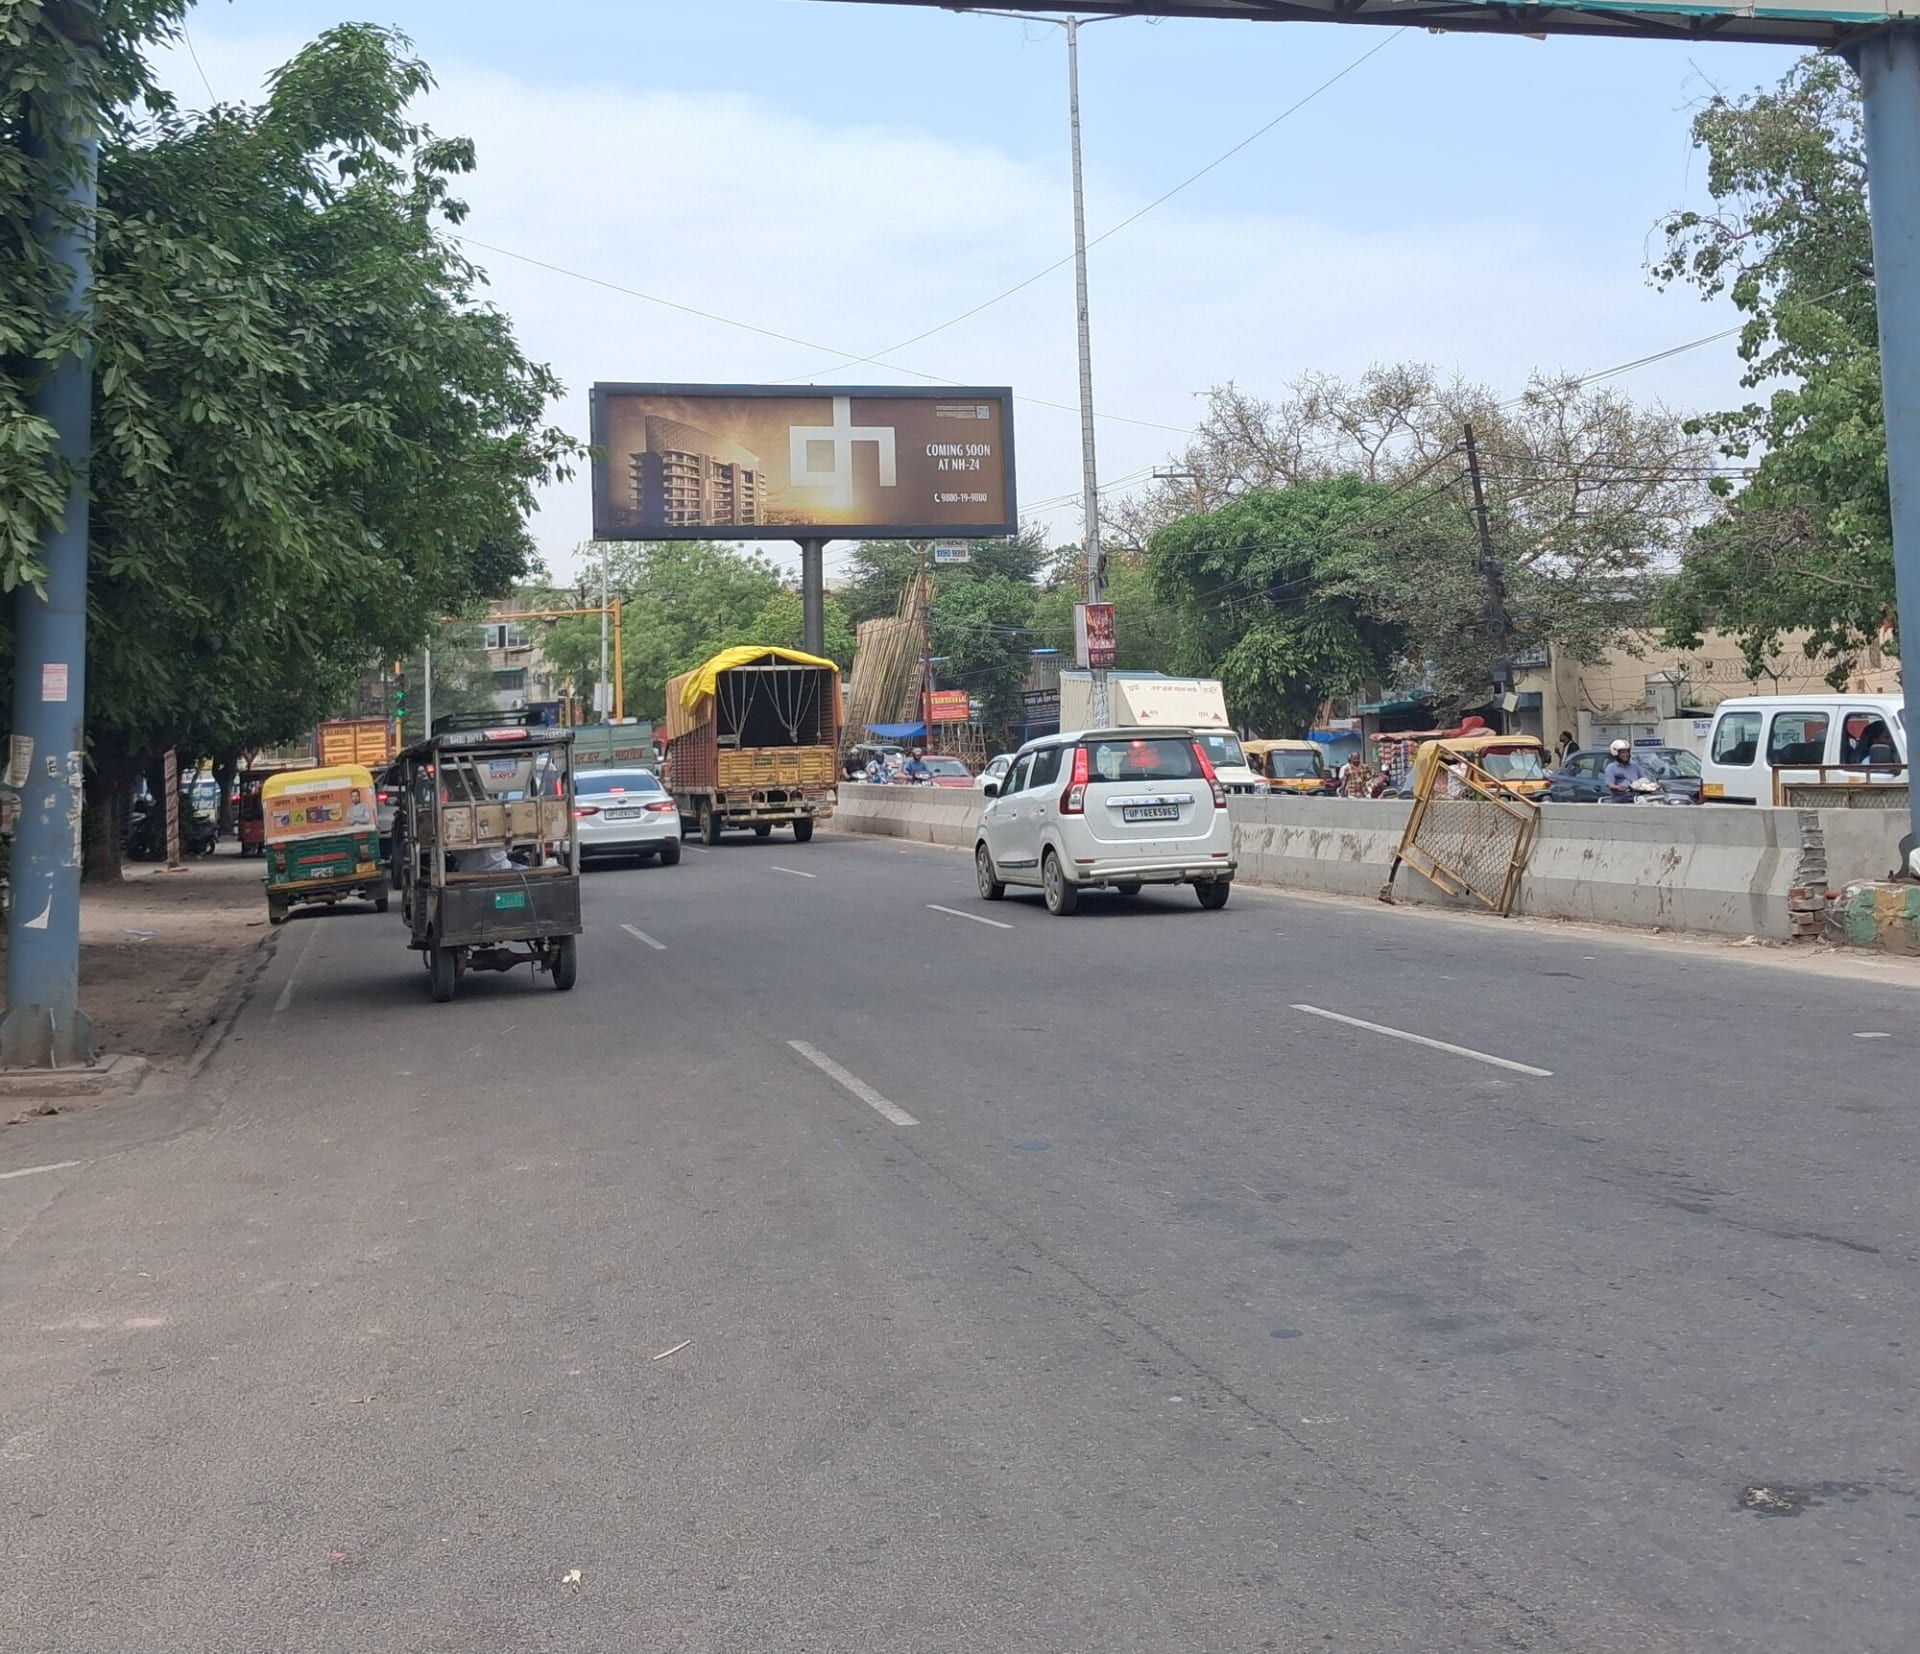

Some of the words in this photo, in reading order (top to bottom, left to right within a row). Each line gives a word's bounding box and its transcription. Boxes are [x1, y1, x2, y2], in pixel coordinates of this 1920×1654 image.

[926, 443, 964, 456] COMING
[965, 443, 991, 456] SOON
[938, 458, 949, 471] AT
[951, 457, 980, 471] NH-24
